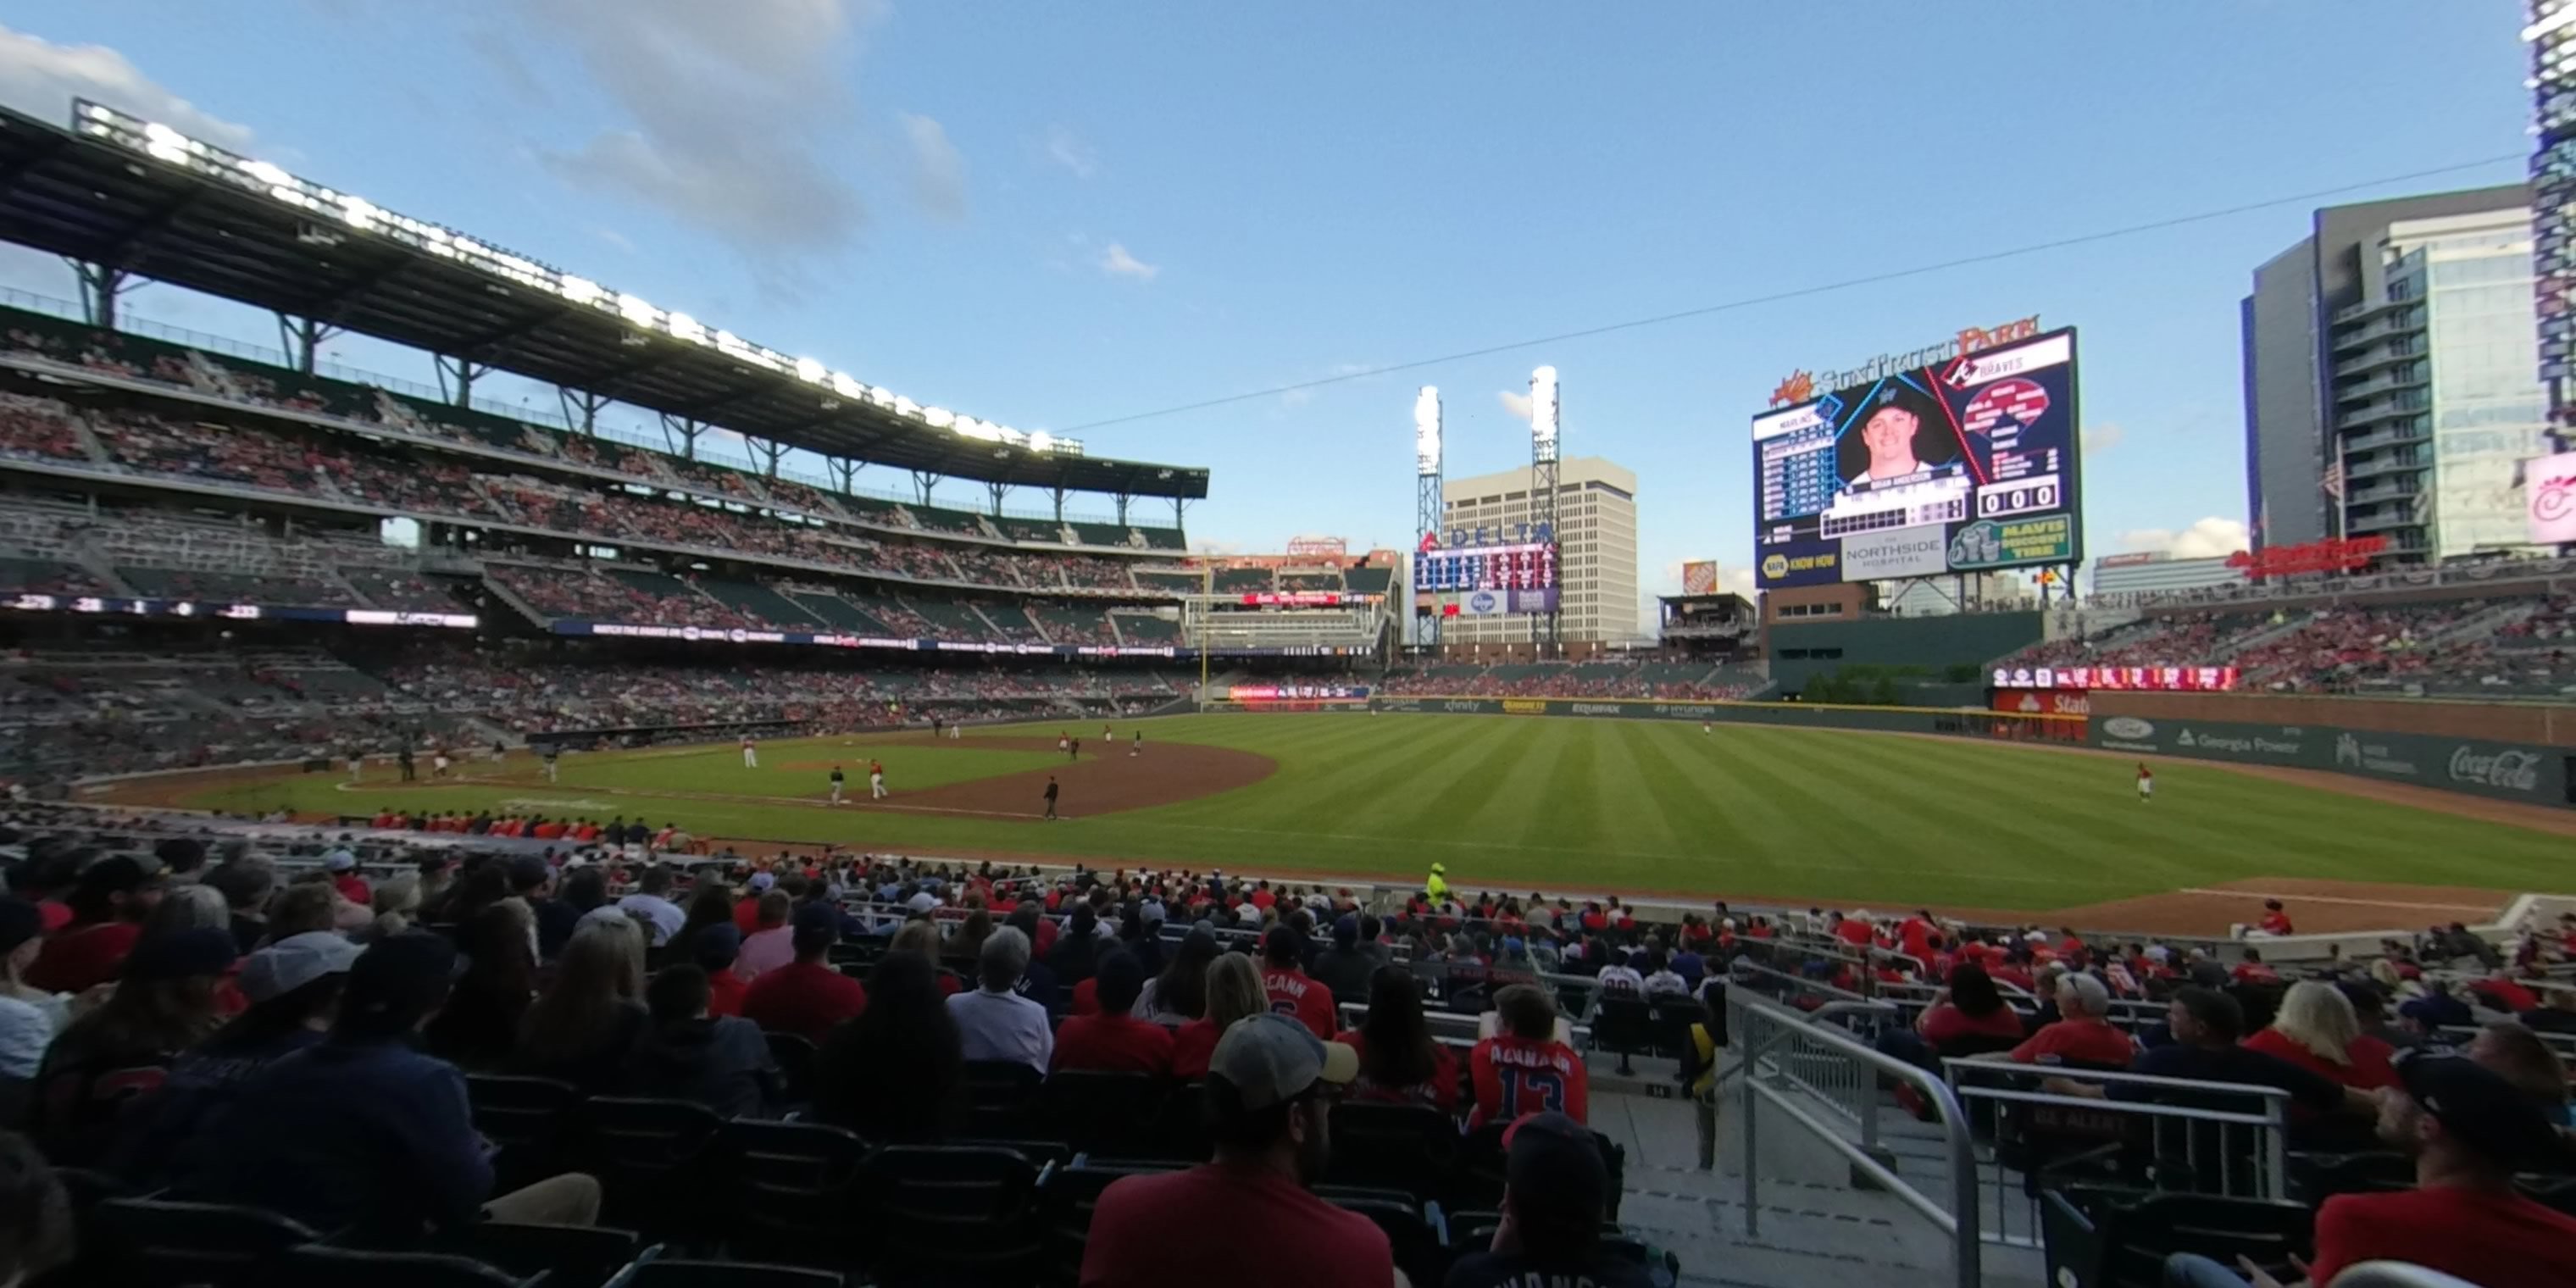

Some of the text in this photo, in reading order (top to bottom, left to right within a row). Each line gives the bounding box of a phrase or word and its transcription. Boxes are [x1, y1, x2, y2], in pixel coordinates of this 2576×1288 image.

[1956, 314, 2040, 356] PARK
[1980, 357, 2024, 378] BRAVES
[1986, 486, 2051, 513] 0 0 0
[1451, 523, 1553, 546] DELTA
[2001, 519, 2065, 537] MAVIS
[1846, 540, 1940, 560] NORTHSIDE
[2012, 545, 2056, 558] TIRE
[1767, 561, 1785, 571] NAPA
[1862, 555, 1922, 567] HOSPITAL
[1444, 699, 1480, 712] xfinity
[1572, 702, 1620, 714] EQUIFAX
[2198, 734, 2301, 754] Georgia Power
[1499, 1066, 1565, 1119] 13
